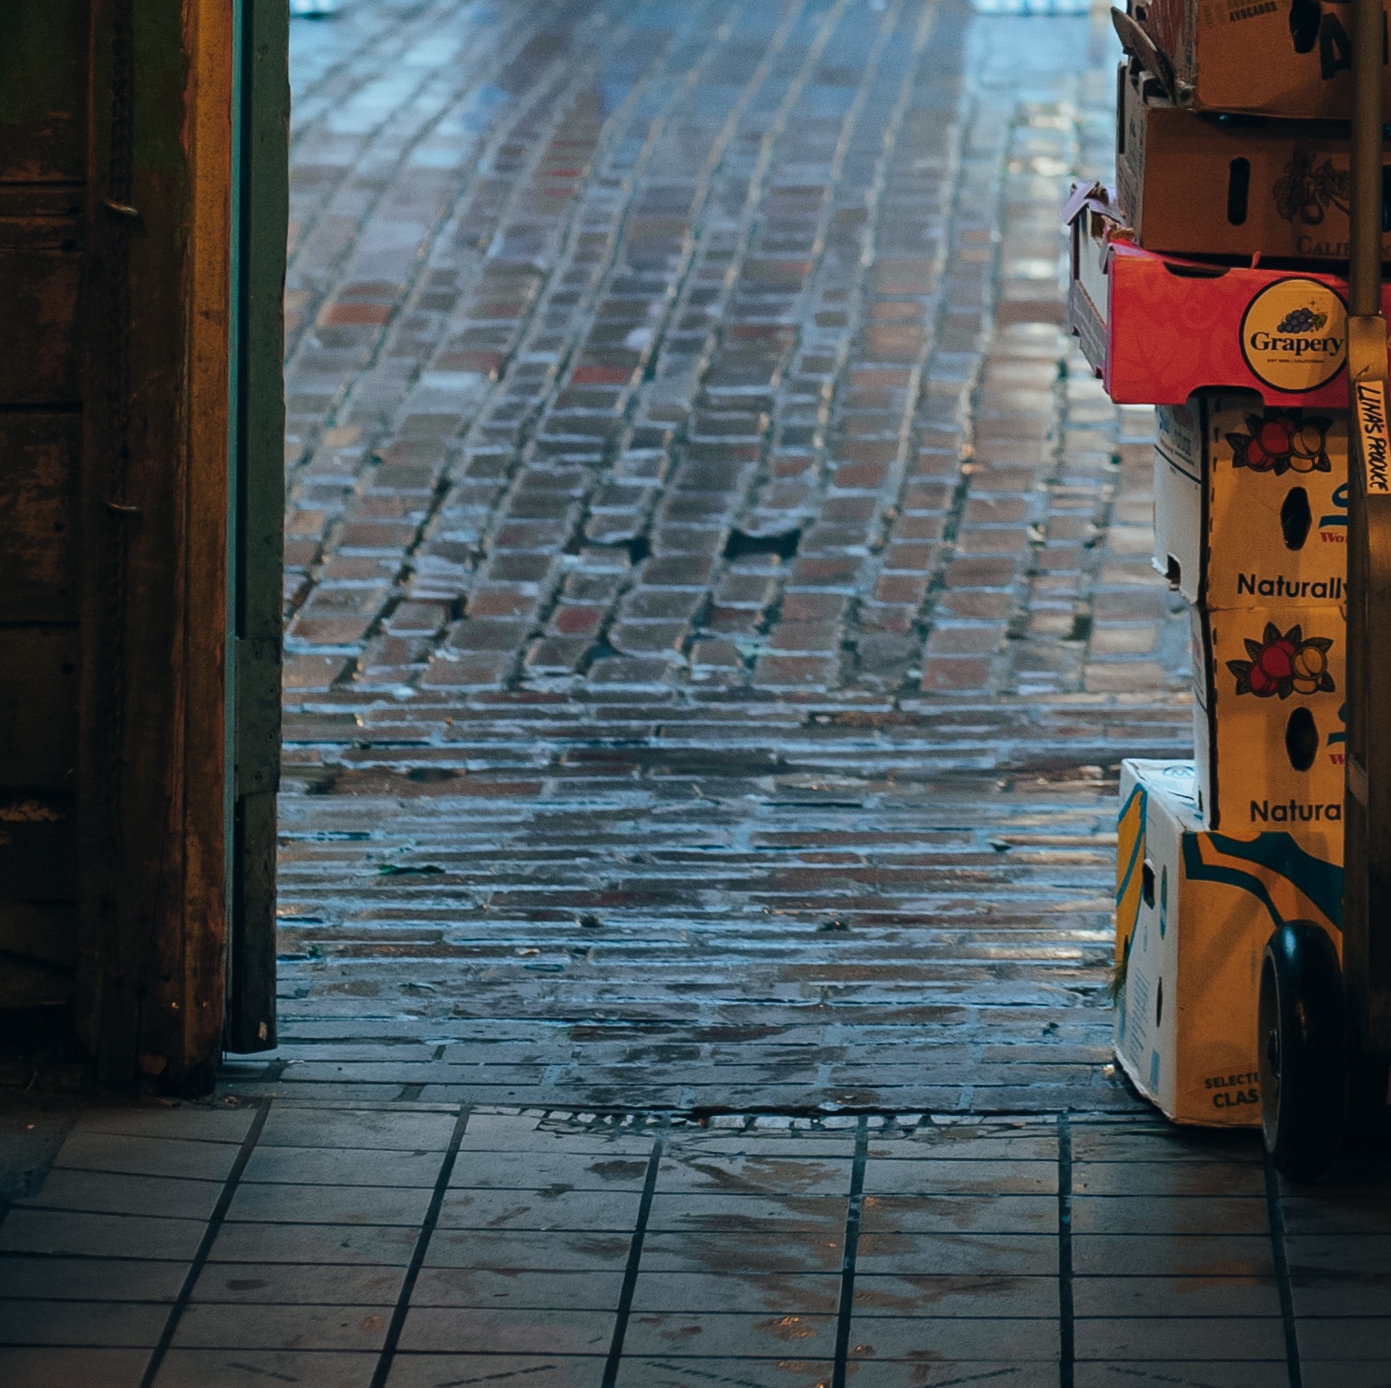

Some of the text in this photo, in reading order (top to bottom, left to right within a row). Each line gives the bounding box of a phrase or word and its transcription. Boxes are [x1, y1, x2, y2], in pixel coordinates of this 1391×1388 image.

[1229, 1, 1278, 23] AVOCADOS
[1250, 331, 1344, 357] Grapery
[1249, 799, 1342, 823] Natura
[1204, 1071, 1259, 1089] SELECTE
[1213, 1088, 1260, 1109] CLAS
